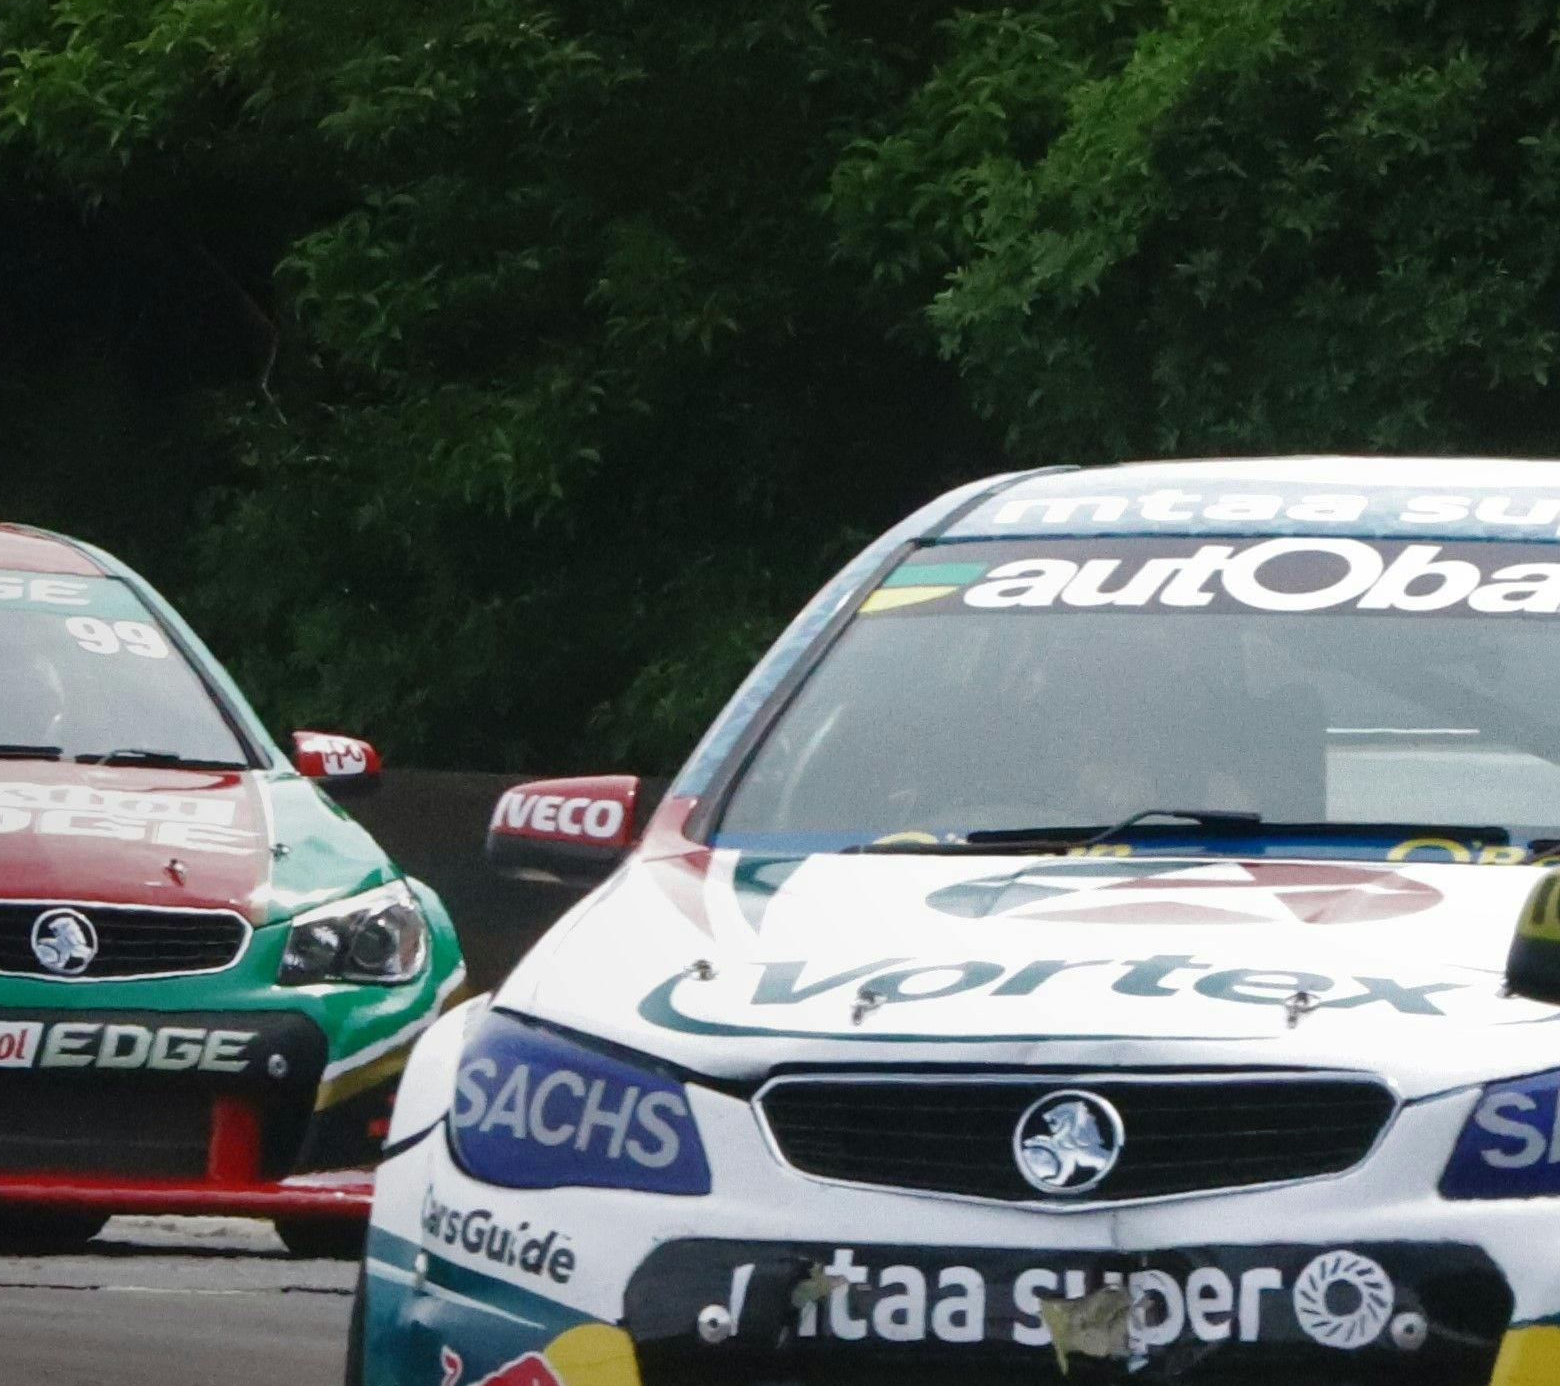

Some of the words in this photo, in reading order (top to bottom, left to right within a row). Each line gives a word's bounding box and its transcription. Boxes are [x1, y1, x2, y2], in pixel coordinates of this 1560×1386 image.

[993, 487, 1368, 525] mtaa
[66, 617, 170, 658] 99
[491, 793, 625, 840] IVECO
[39, 1024, 262, 1072] EDGE
[453, 1059, 686, 1168] SACHS
